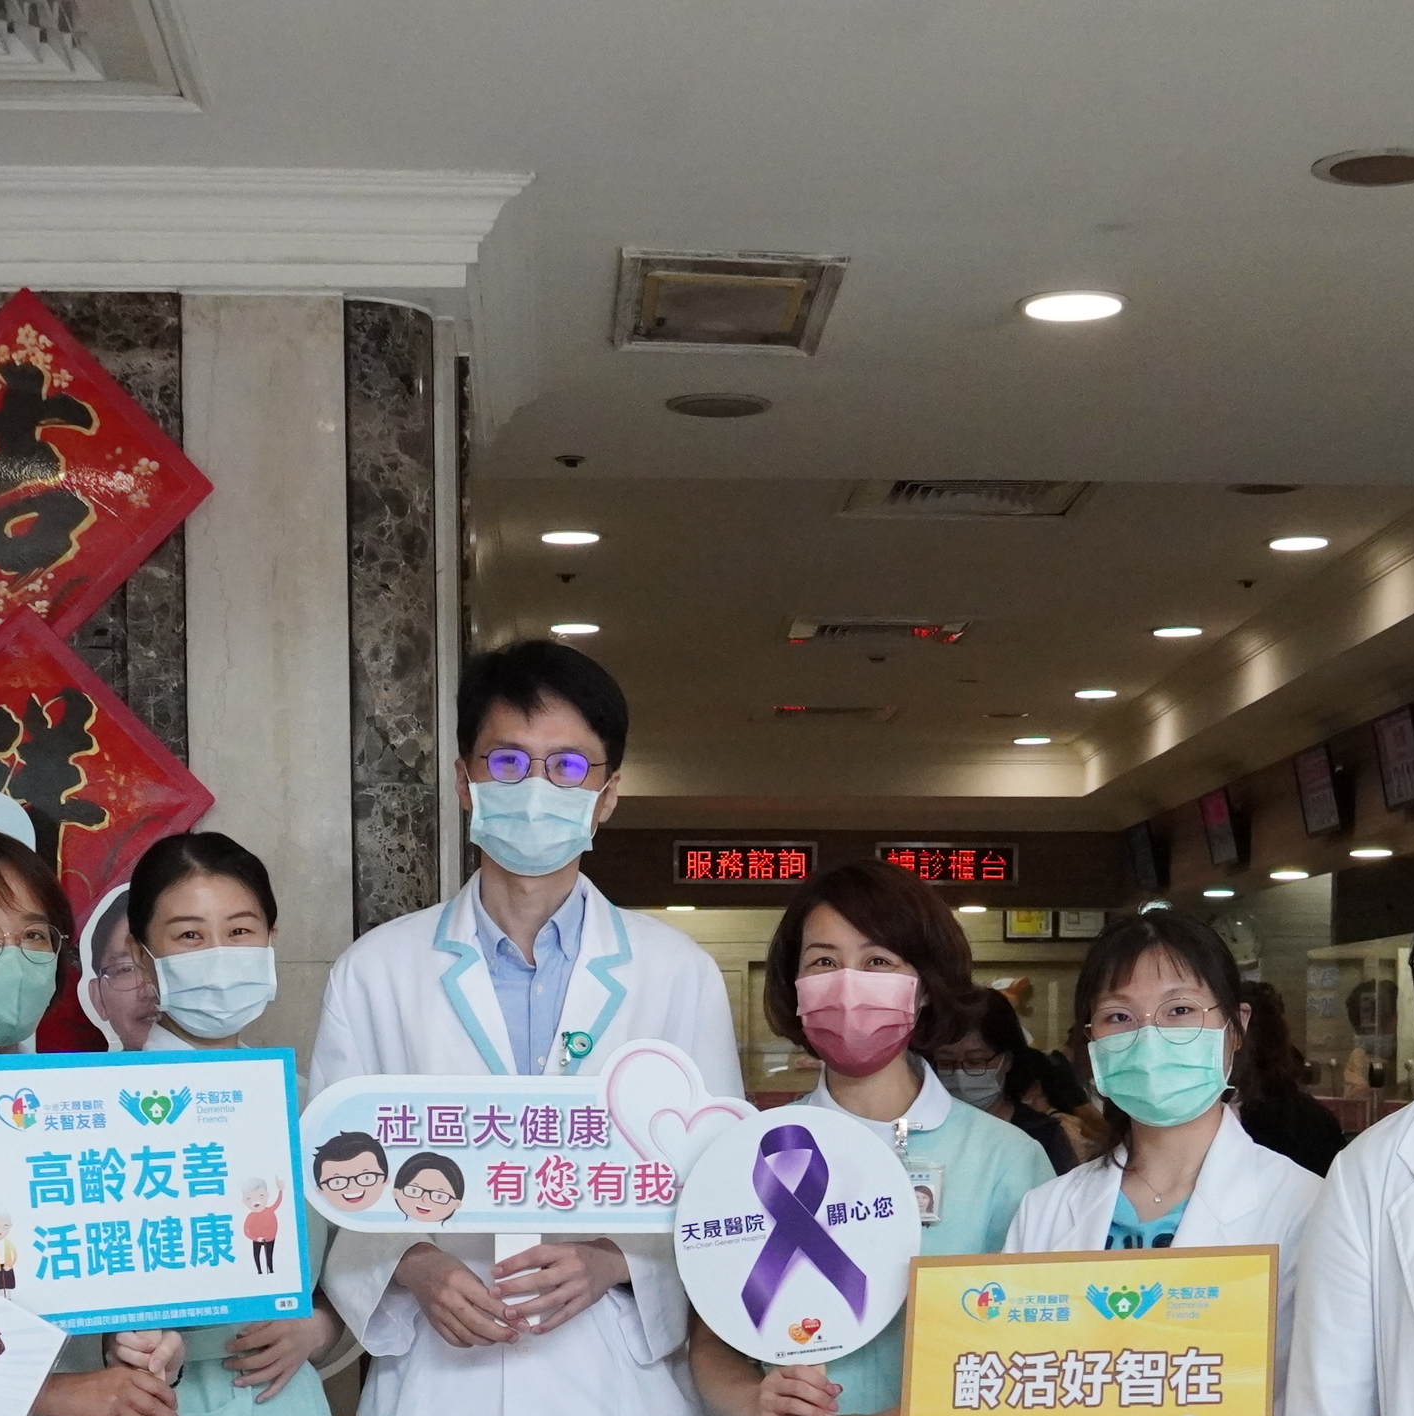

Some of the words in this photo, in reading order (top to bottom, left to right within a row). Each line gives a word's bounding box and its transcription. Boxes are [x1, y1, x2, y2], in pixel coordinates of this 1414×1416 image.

[685, 849, 807, 880] 服務諮詢
[195, 1089, 244, 1104] 失智友善
[196, 1104, 235, 1114] Dementia
[44, 1113, 107, 1132] 失智友善
[197, 1115, 228, 1124] Friends
[375, 1104, 610, 1146] 社區大健康
[25, 1142, 229, 1209] 高齡友善
[485, 1154, 676, 1208] 有您有我
[826, 1196, 894, 1227] 關心您
[680, 1213, 766, 1243] 天晟醫院
[32, 1212, 237, 1281] 活躍健康
[1167, 1286, 1220, 1300] 失智友善
[1006, 1307, 1071, 1323] 失智友善
[953, 1346, 1223, 1410] 齡活好智在
